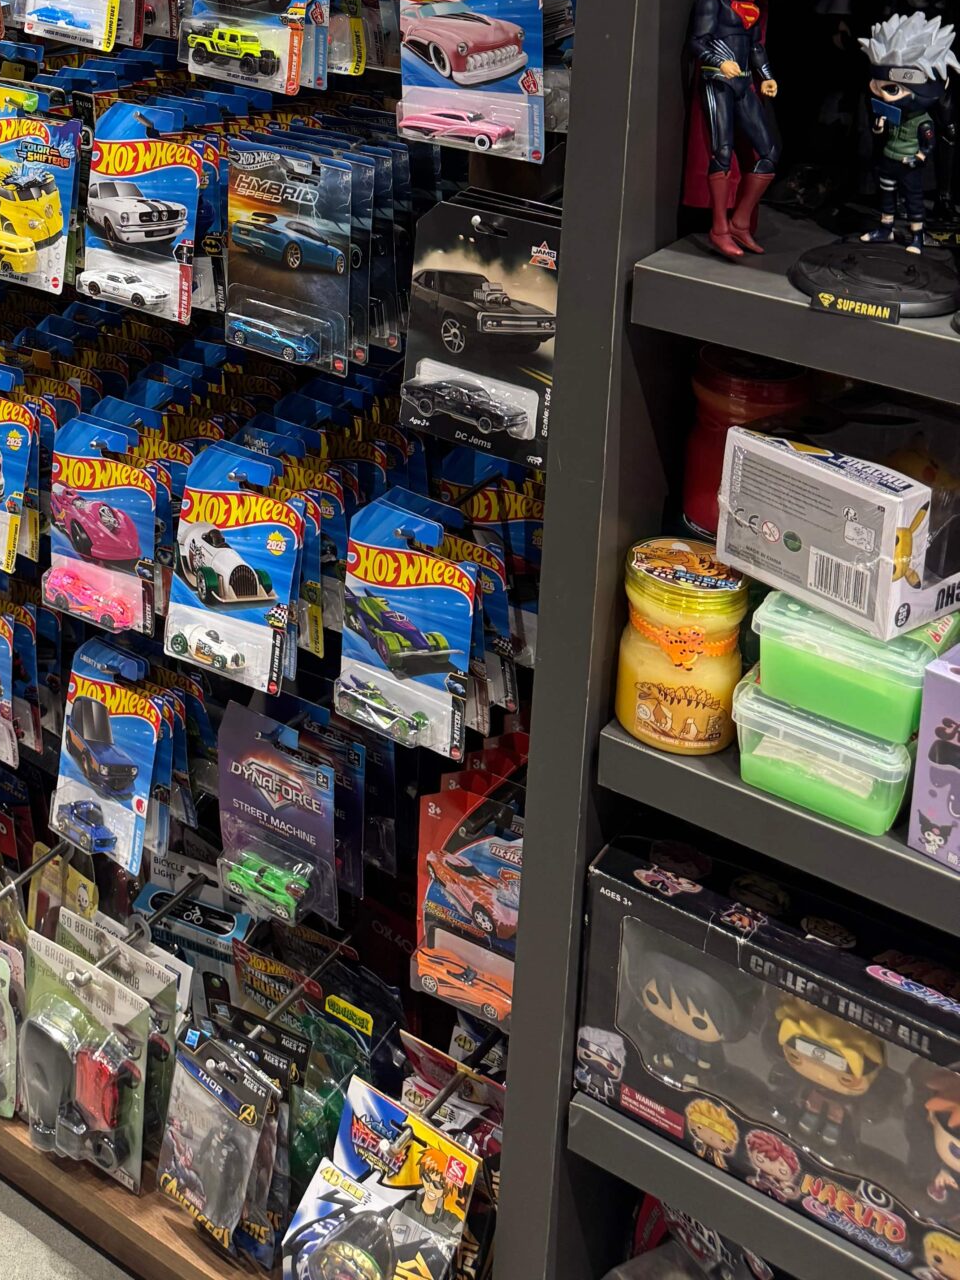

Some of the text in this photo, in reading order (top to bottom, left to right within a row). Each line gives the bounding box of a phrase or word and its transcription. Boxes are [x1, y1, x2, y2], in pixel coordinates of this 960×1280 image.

[21, 140, 50, 157] COLOR
[27, 151, 70, 169] SHIFTERS
[236, 187, 283, 203] SPEED
[532, 248, 556, 259] JAMS
[837, 298, 890, 319] SUPERMAN
[455, 430, 468, 441] DC
[540, 414, 550, 439] Scale:
[838, 454, 914, 493] PIKACHU
[266, 539, 286, 551] 2026
[452, 711, 462, 747] X-RAYCERS
[231, 762, 325, 815] DYNAFORCE
[317, 772, 329, 787] 3+
[427, 802, 441, 815] 3+
[233, 798, 317, 846] STREET MACHINE
[153, 857, 184, 873] BICYCLE
[153, 869, 177, 882] LIGHT
[600, 887, 633, 907] AGES 3+
[749, 953, 932, 1055] COLLECT ALL
[282, 1039, 306, 1054] AGES 4+
[264, 1054, 288, 1070] AGES 4+
[197, 1068, 223, 1096] THOR
[243, 1078, 266, 1098] AGES 4+
[321, 1166, 341, 1188] 4D
[800, 1173, 907, 1244] NARUTO
